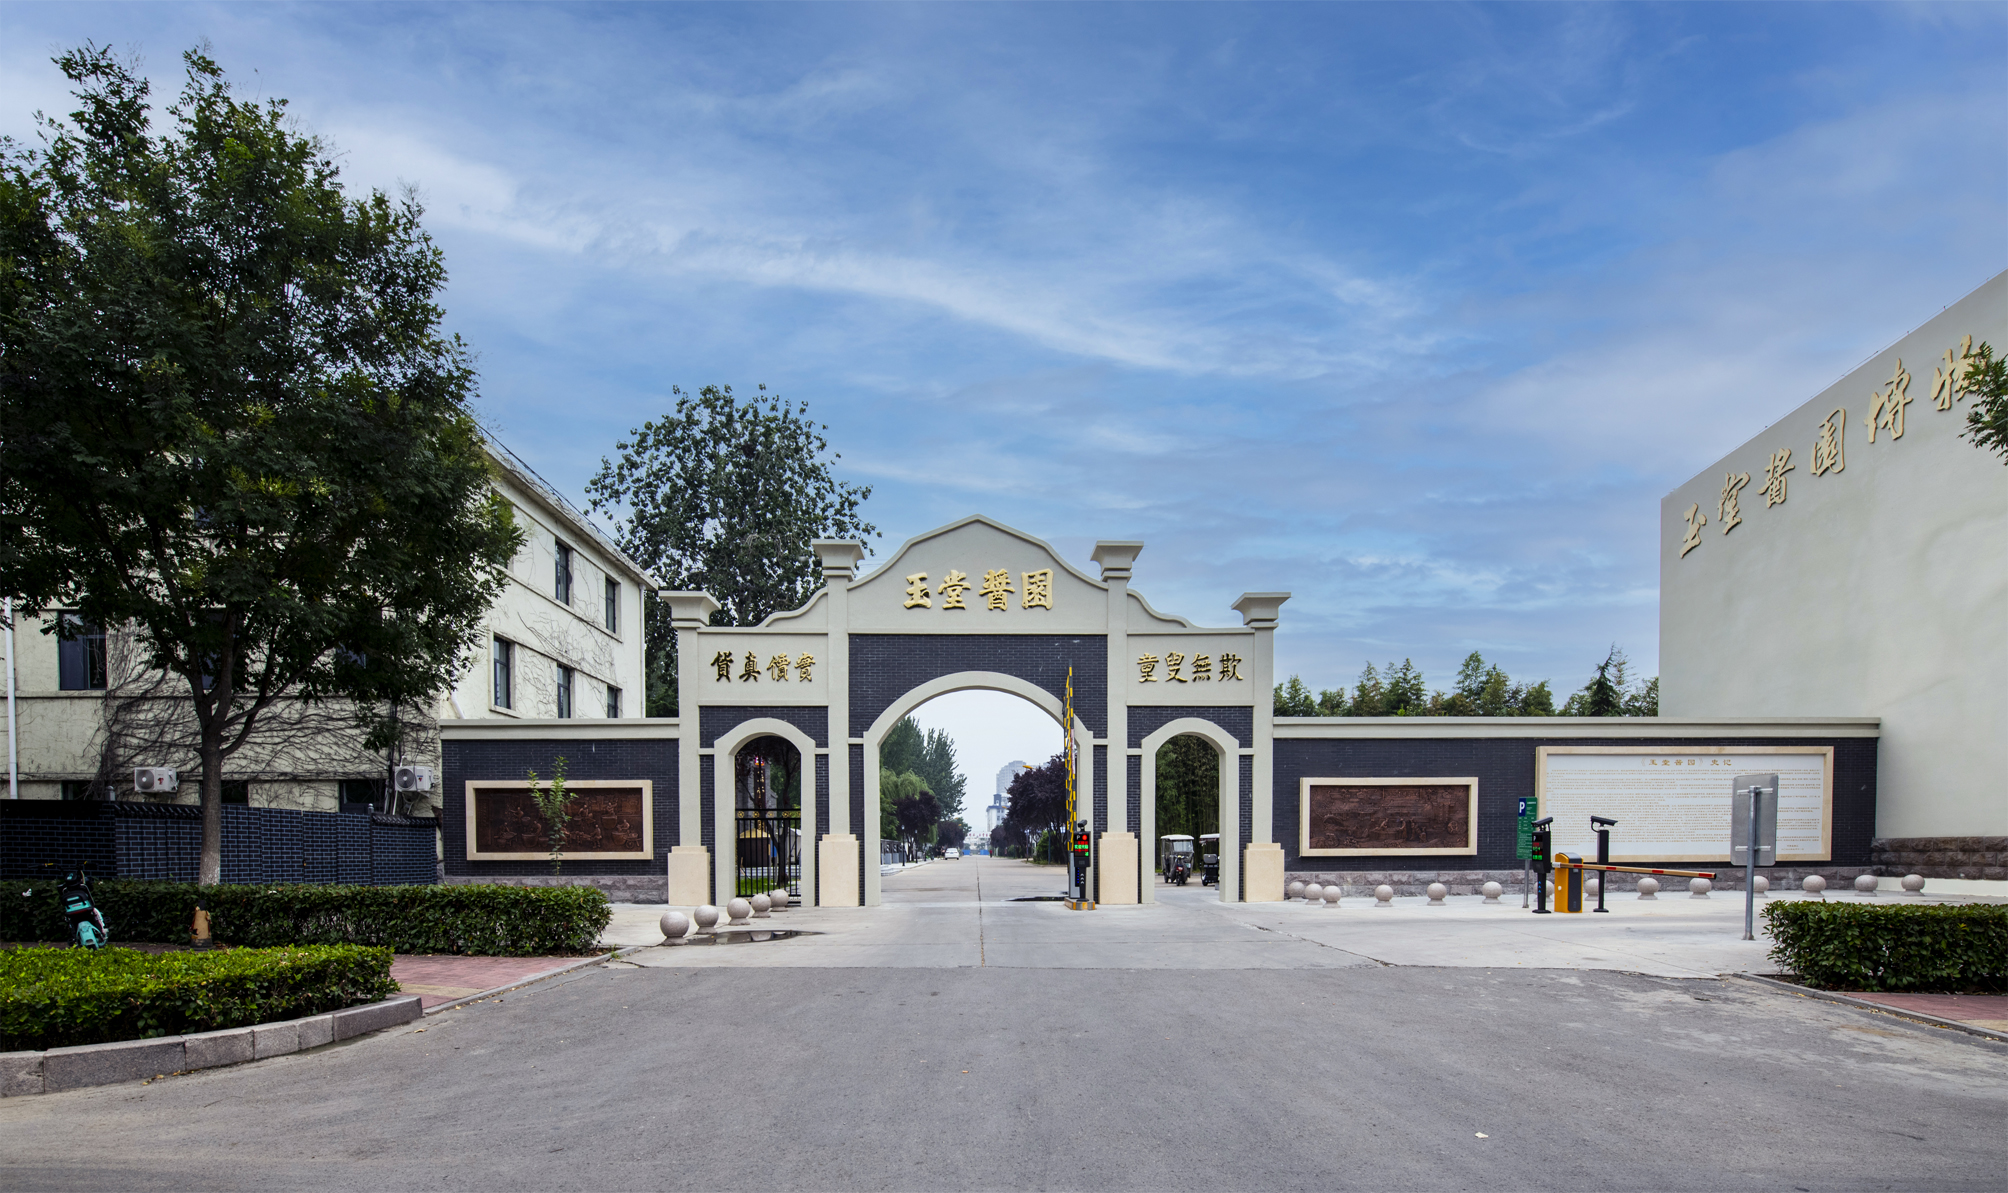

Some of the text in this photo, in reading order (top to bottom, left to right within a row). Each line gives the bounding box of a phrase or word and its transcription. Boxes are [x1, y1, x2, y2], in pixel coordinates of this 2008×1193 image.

[710, 650, 816, 682] 貨真價實
[1137, 651, 1244, 683] 童叟無欺
[1519, 801, 1526, 814] P
